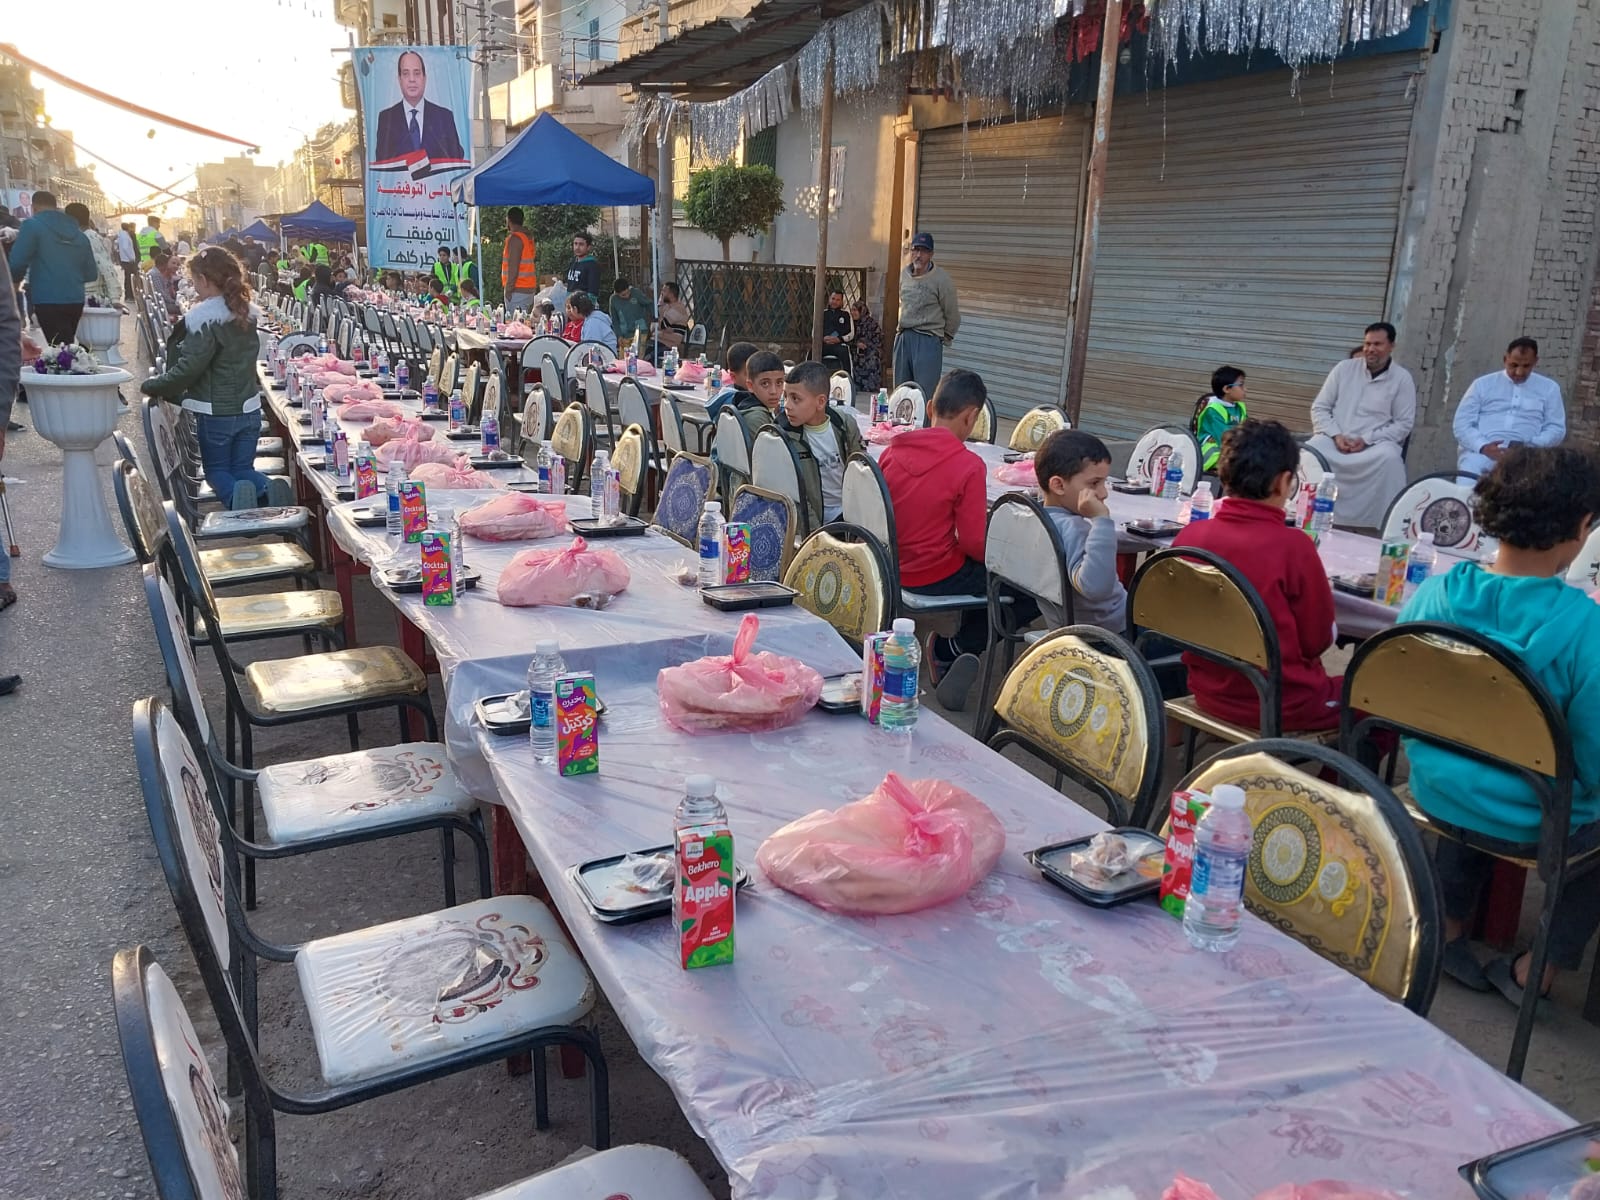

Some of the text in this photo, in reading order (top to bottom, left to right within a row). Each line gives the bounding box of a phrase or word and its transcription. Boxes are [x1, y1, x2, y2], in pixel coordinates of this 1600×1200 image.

[376, 180, 427, 199] التوفيقية
[386, 224, 455, 245] التوفيقية
[423, 561, 448, 569] Cocktail
[562, 712, 594, 735] كوكتيل
[1167, 834, 1193, 860] Appl
[684, 880, 729, 903] Apple
